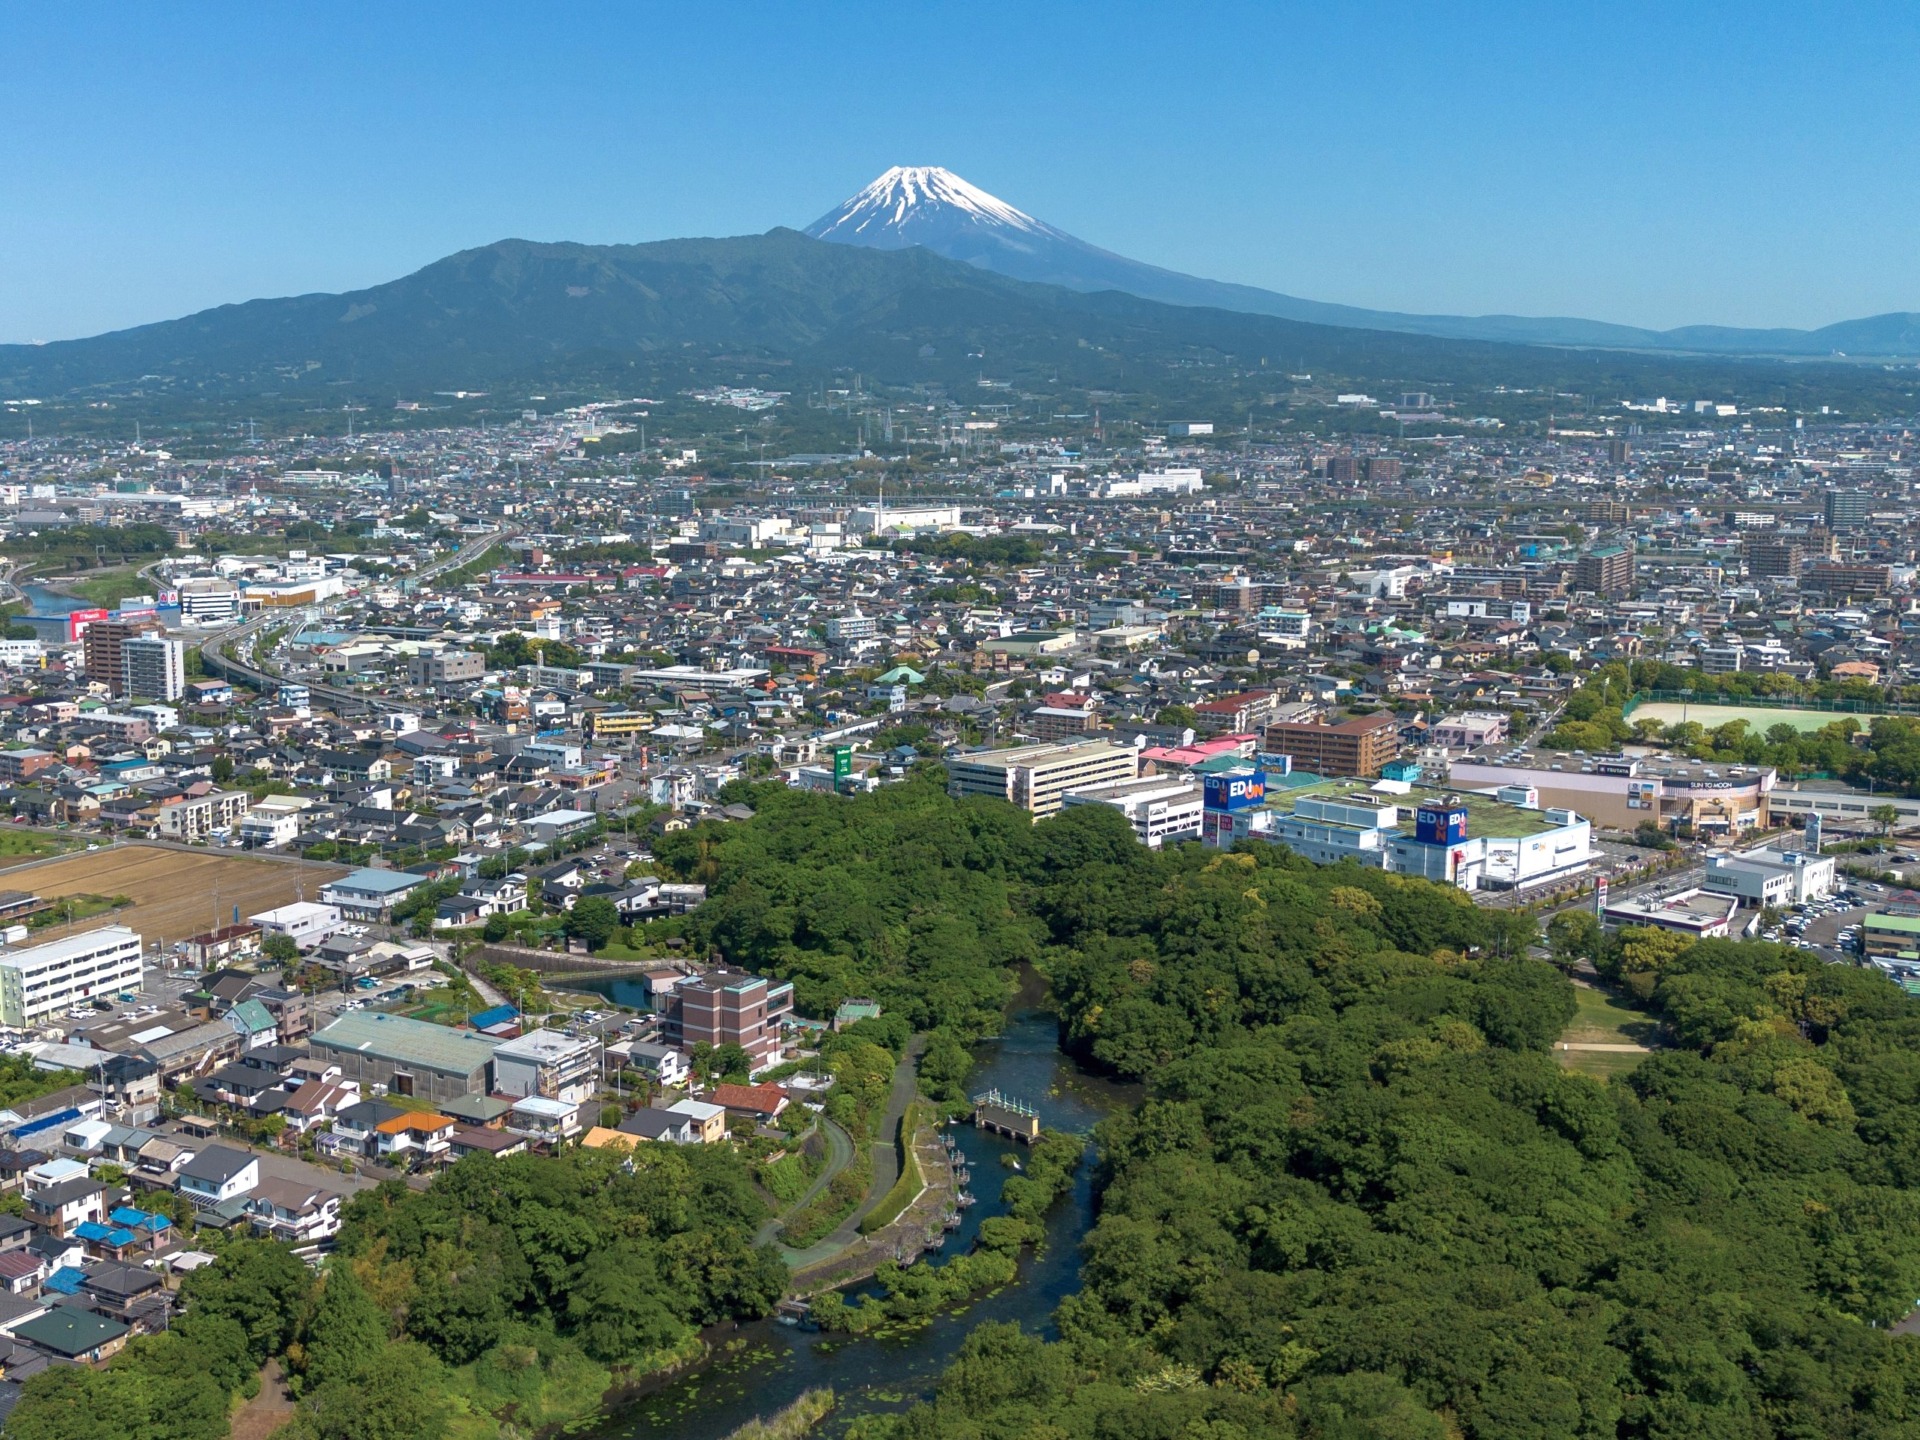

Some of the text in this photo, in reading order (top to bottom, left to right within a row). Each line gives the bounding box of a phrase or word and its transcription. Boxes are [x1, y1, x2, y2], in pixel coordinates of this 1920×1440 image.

[1230, 779, 1263, 799] EDION
[1418, 811, 1447, 842] EDION
[1449, 812, 1467, 837] EDION
